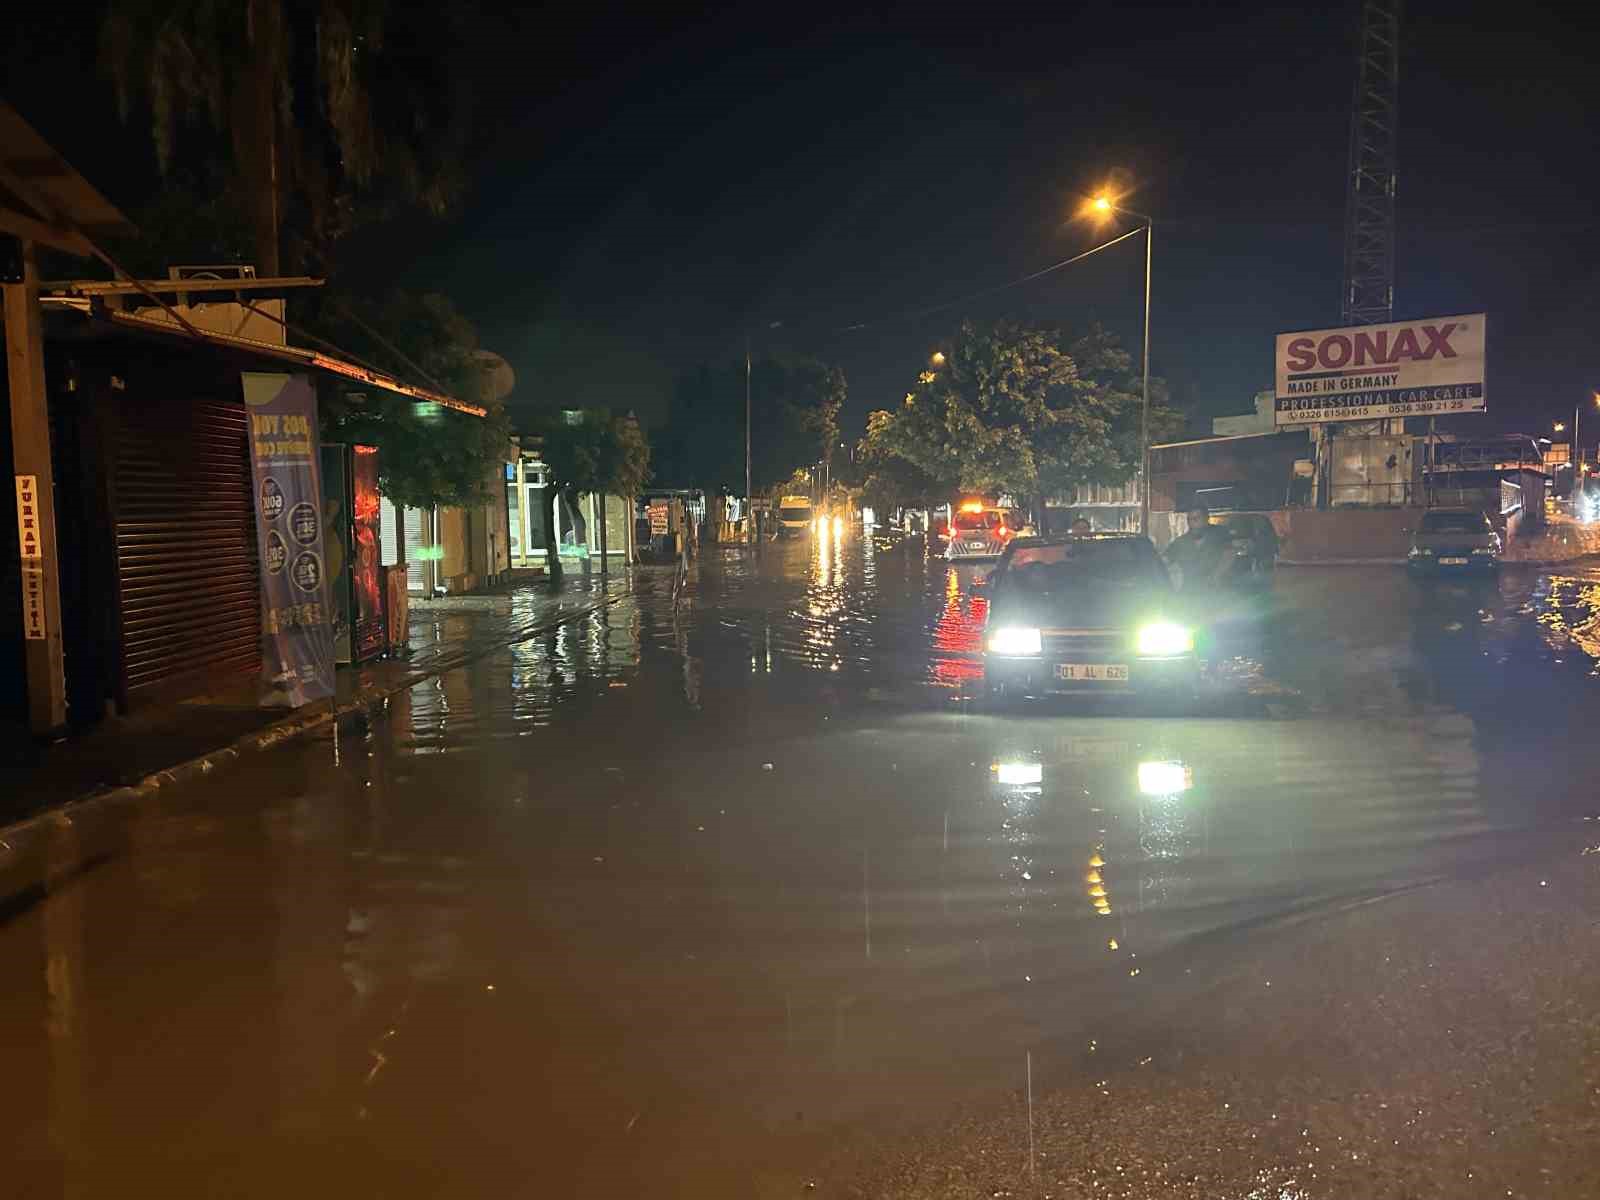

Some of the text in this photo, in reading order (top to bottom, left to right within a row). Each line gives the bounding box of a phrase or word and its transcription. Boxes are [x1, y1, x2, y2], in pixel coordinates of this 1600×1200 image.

[1286, 323, 1457, 371] SONAX
[1287, 374, 1398, 394] MADE IN GERMANY
[1280, 386, 1473, 410] PROFESSIONAL CAR CARE
